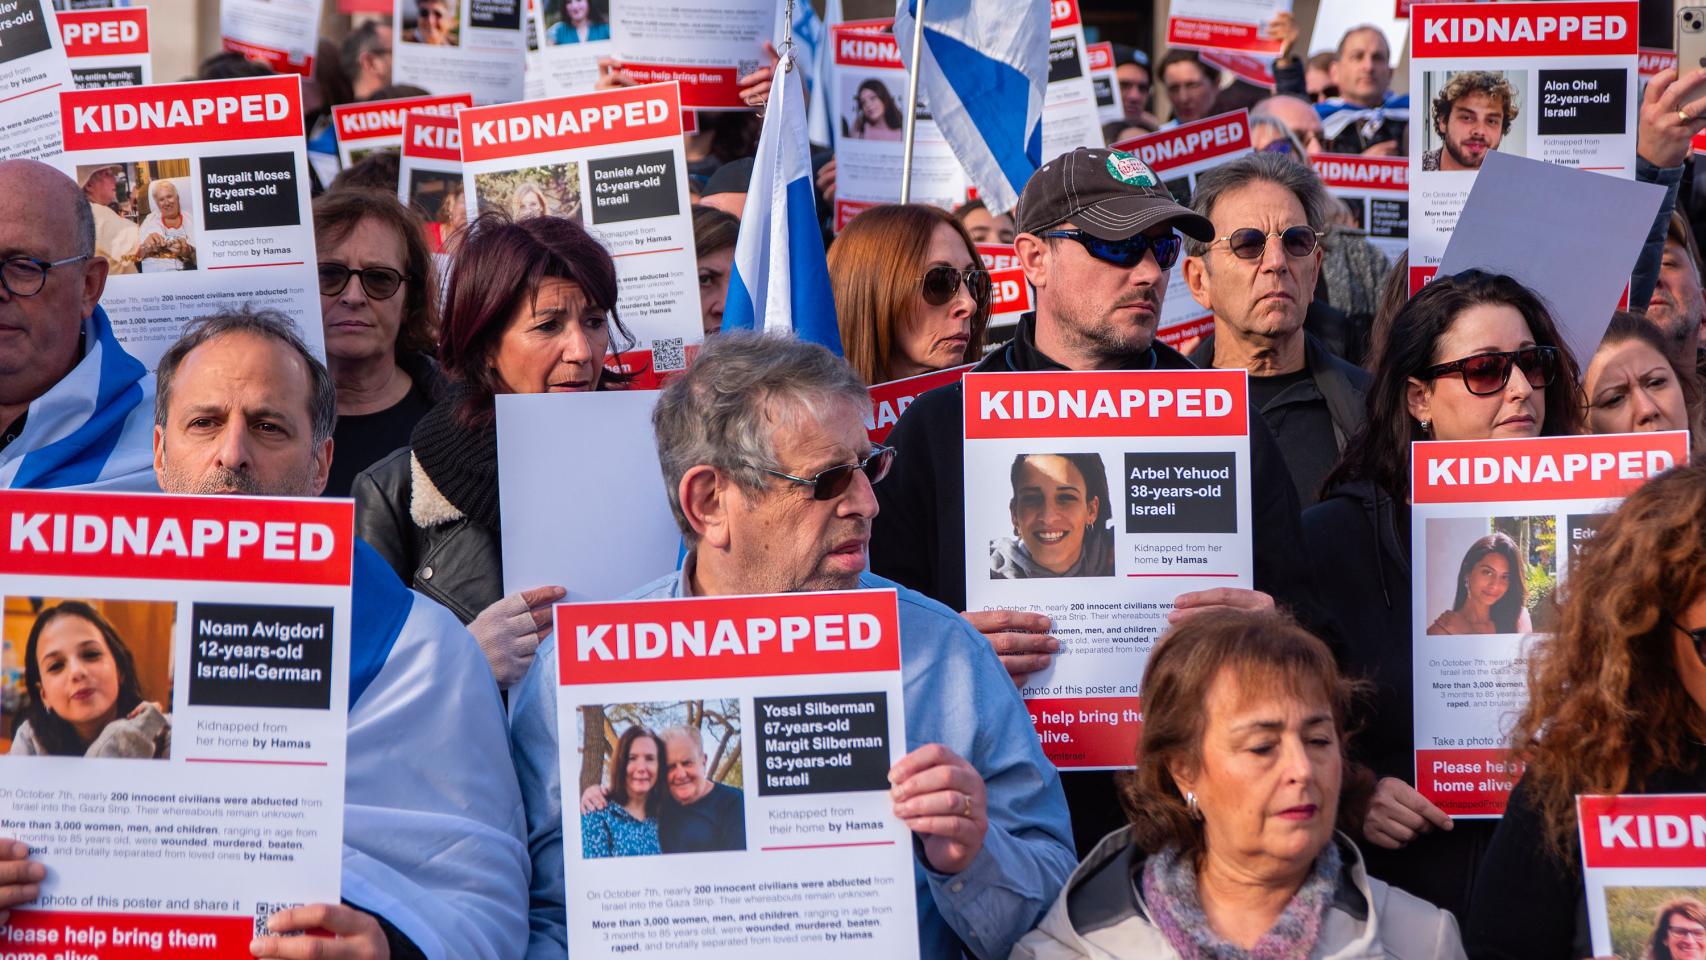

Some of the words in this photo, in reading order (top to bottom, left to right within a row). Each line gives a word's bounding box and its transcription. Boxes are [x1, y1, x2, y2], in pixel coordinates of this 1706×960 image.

[1424, 14, 1627, 43] KIDNAPPED
[22, 72, 47, 84] Hamas
[1544, 79, 1569, 91] Alon
[1572, 79, 1597, 90] Ohel
[1544, 92, 1609, 106] 22-years-old
[73, 93, 289, 134] KIDNAPPED
[1544, 106, 1576, 118] Israeli
[472, 98, 669, 147] KIDNAPPED
[1129, 122, 1244, 164] IDNAPPED
[207, 170, 252, 187] Margalit
[254, 167, 291, 181] Moses
[594, 164, 633, 179] Daniele
[635, 161, 666, 178] Alony
[207, 183, 277, 201] 78-years-old
[595, 175, 660, 196] 43-years-old
[209, 199, 243, 212] Israeli
[596, 192, 629, 207] Israeli
[979, 387, 1233, 420] KIDNAPPED
[1130, 467, 1169, 480] Arbel
[1174, 466, 1229, 479] Yehuod
[1428, 450, 1674, 487] KIDNAPPED
[1130, 484, 1221, 501] 38-years-old
[1131, 502, 1175, 516] Israeli
[9, 512, 336, 562] KIDNAPPED
[1134, 543, 1183, 554] Kidnapped
[1185, 543, 1205, 552] from
[1207, 543, 1222, 552] her
[1134, 555, 1159, 564] home
[1161, 555, 1173, 566] by
[1176, 555, 1207, 564] Hamas
[1070, 602, 1084, 610] 200
[1086, 601, 1122, 610] innocent
[1123, 601, 1157, 609] civilians
[199, 620, 248, 637] Noam
[251, 621, 323, 643] Avigdori
[576, 612, 882, 662] KIDNAPPED
[1106, 625, 1121, 634] and
[198, 640, 303, 663] 12-years-old
[197, 661, 321, 681] Israeli-German
[1021, 685, 1050, 699] photo
[1052, 684, 1062, 695] of
[1065, 684, 1082, 695] this
[1085, 683, 1116, 697] poster
[1119, 683, 1139, 694] and
[762, 700, 801, 717] Yossi
[804, 698, 875, 715] Silberman
[197, 719, 259, 735] Kidnapped
[262, 721, 287, 733] from
[764, 716, 849, 738] 67-years-old
[1042, 710, 1074, 727] help
[1078, 709, 1118, 726] bring
[196, 735, 213, 746] her
[217, 735, 248, 747] home
[252, 736, 266, 750] by
[271, 737, 310, 749] Hamas
[765, 736, 809, 756] Margit
[812, 733, 882, 751] Silberman
[765, 751, 851, 773] 63-years-old
[1433, 760, 1481, 773] Please
[766, 771, 809, 787] Israeli
[1433, 779, 1474, 792] home
[110, 791, 128, 802] 200
[131, 792, 175, 803] innocent
[178, 793, 220, 804] civilians
[223, 796, 248, 805] were
[250, 795, 298, 806] abducted
[0, 818, 26, 829] More
[28, 819, 51, 830] than
[54, 820, 82, 832] 3,000
[154, 822, 173, 833] and
[828, 820, 841, 834] by
[845, 819, 883, 831] Hamas
[243, 850, 256, 863] by
[694, 884, 711, 894] 200
[713, 882, 755, 893] innocent
[758, 880, 798, 891] civilians
[800, 881, 824, 889] were
[826, 876, 871, 888] abducted
[42, 893, 77, 909] photo
[80, 894, 93, 907] of
[97, 895, 119, 908] this
[122, 896, 161, 912] poster
[166, 897, 189, 910] and
[193, 898, 228, 911] share
[232, 899, 239, 911] it
[592, 917, 616, 928] More
[619, 916, 640, 927] than
[643, 915, 669, 927] 3,000
[738, 910, 756, 921] and
[64, 928, 107, 948] help
[112, 929, 163, 950] bring
[167, 930, 216, 947] them
